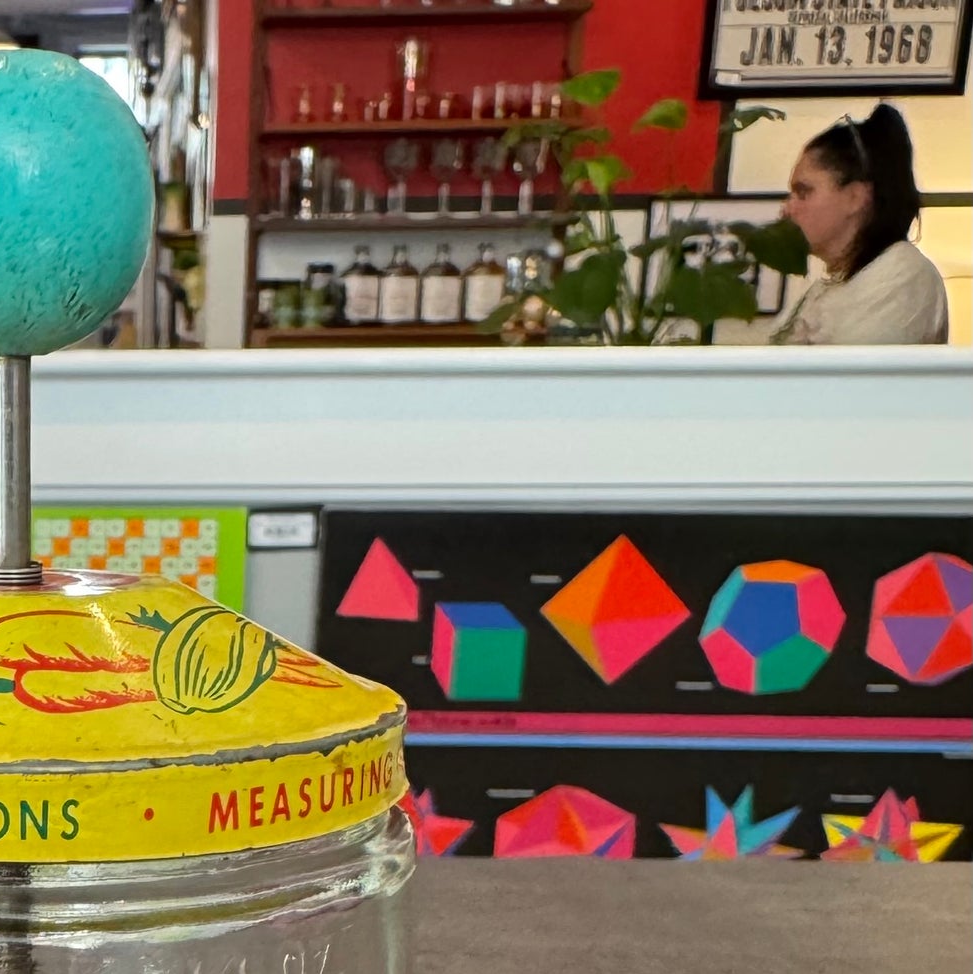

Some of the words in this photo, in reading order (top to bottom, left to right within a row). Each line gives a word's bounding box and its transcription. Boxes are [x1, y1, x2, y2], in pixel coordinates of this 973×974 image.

[740, 26, 804, 66] JAN.
[866, 24, 933, 65] 1968
[208, 751, 393, 834] MEASURING
